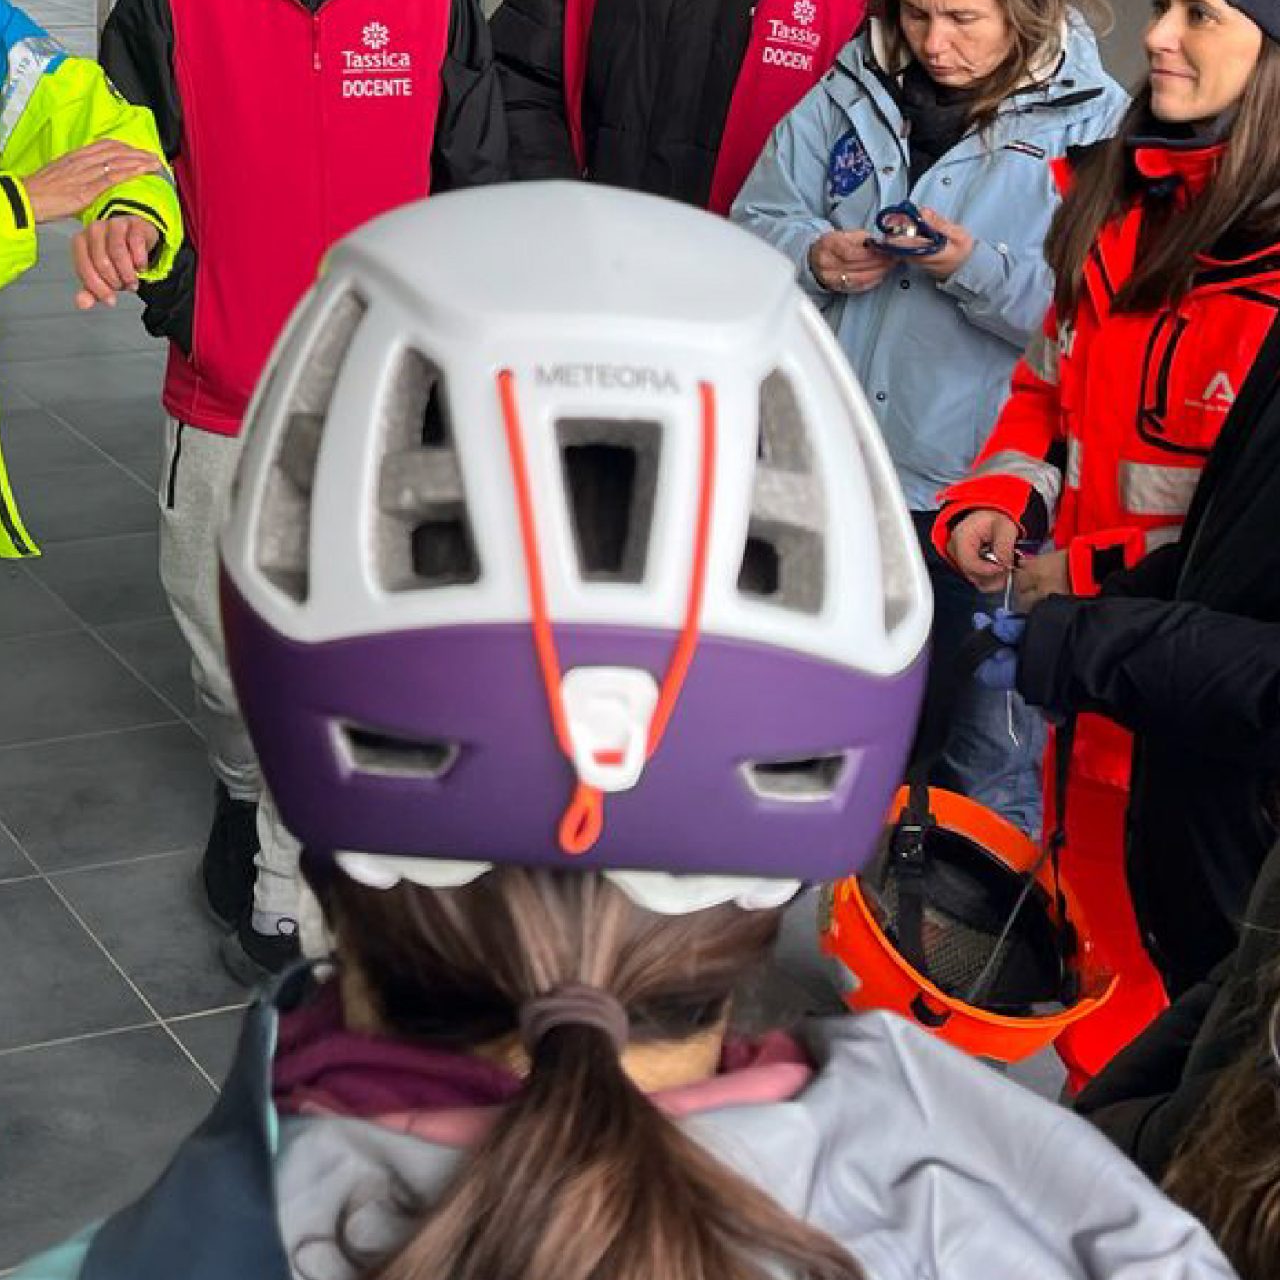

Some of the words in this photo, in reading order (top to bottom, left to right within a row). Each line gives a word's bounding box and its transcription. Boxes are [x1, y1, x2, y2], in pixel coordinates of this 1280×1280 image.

[340, 50, 411, 68] Tassica
[342, 78, 413, 97] DOCENTE
[535, 363, 681, 395] METEORA
